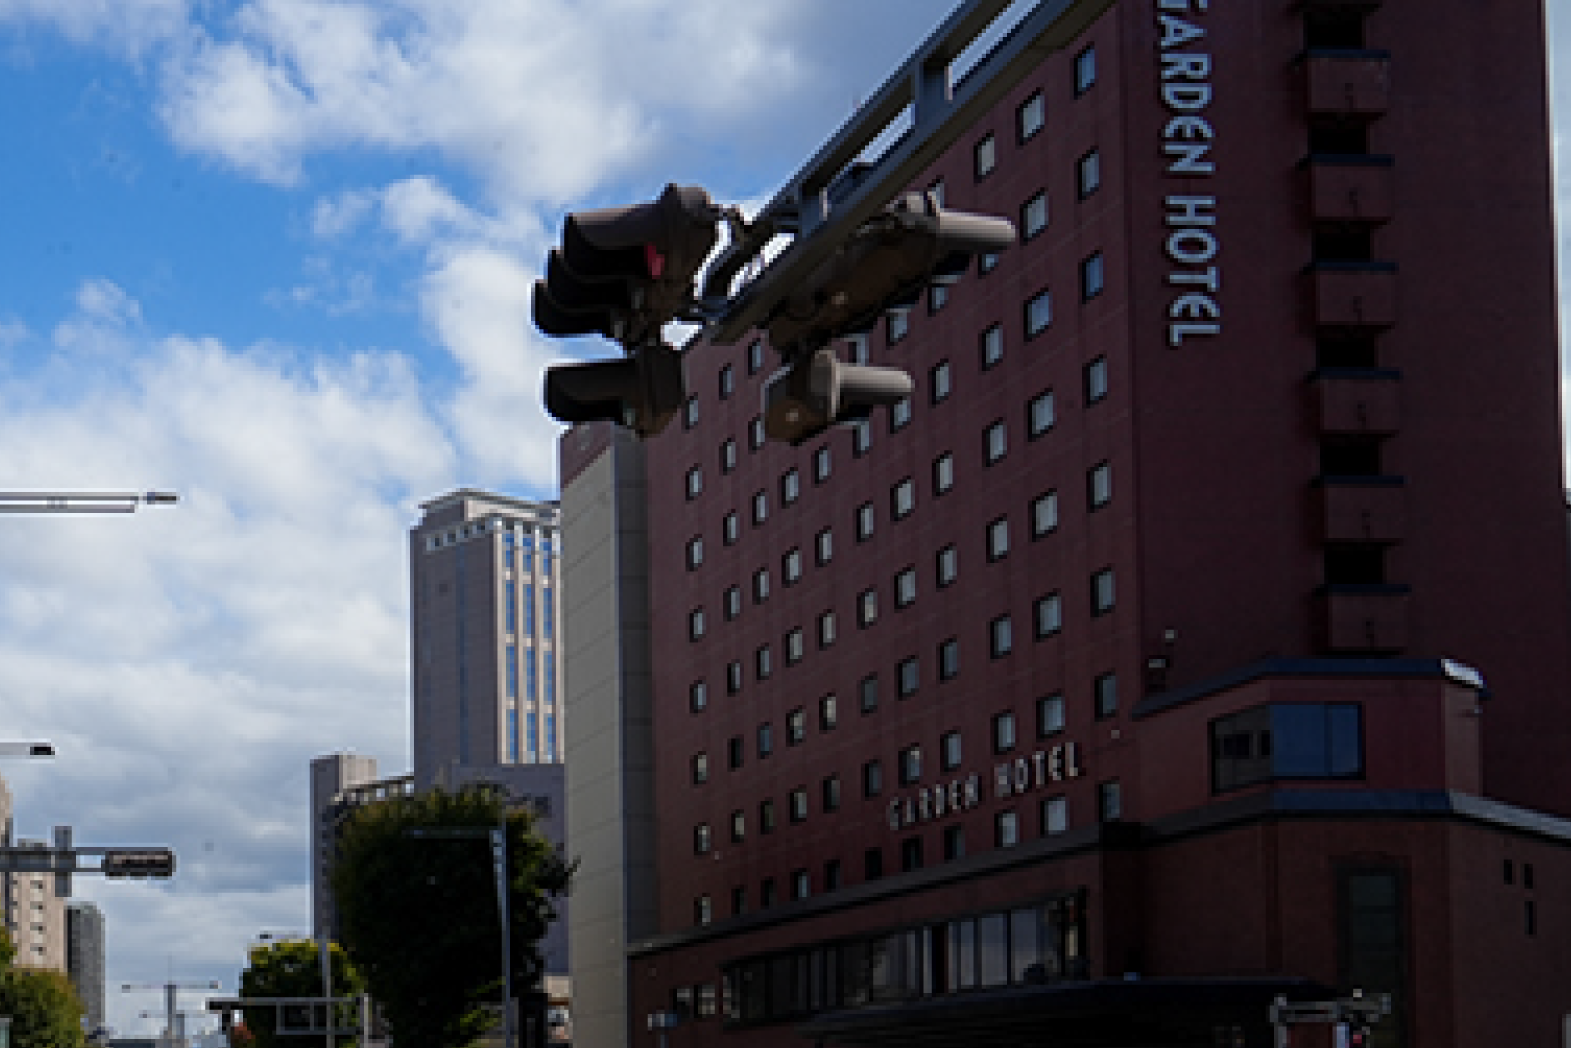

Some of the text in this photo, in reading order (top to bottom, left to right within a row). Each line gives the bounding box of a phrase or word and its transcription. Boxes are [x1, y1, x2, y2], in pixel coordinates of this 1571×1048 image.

[1165, 195, 1220, 346] HOTEL
[887, 742, 1078, 830] GARDEN HOTEL
